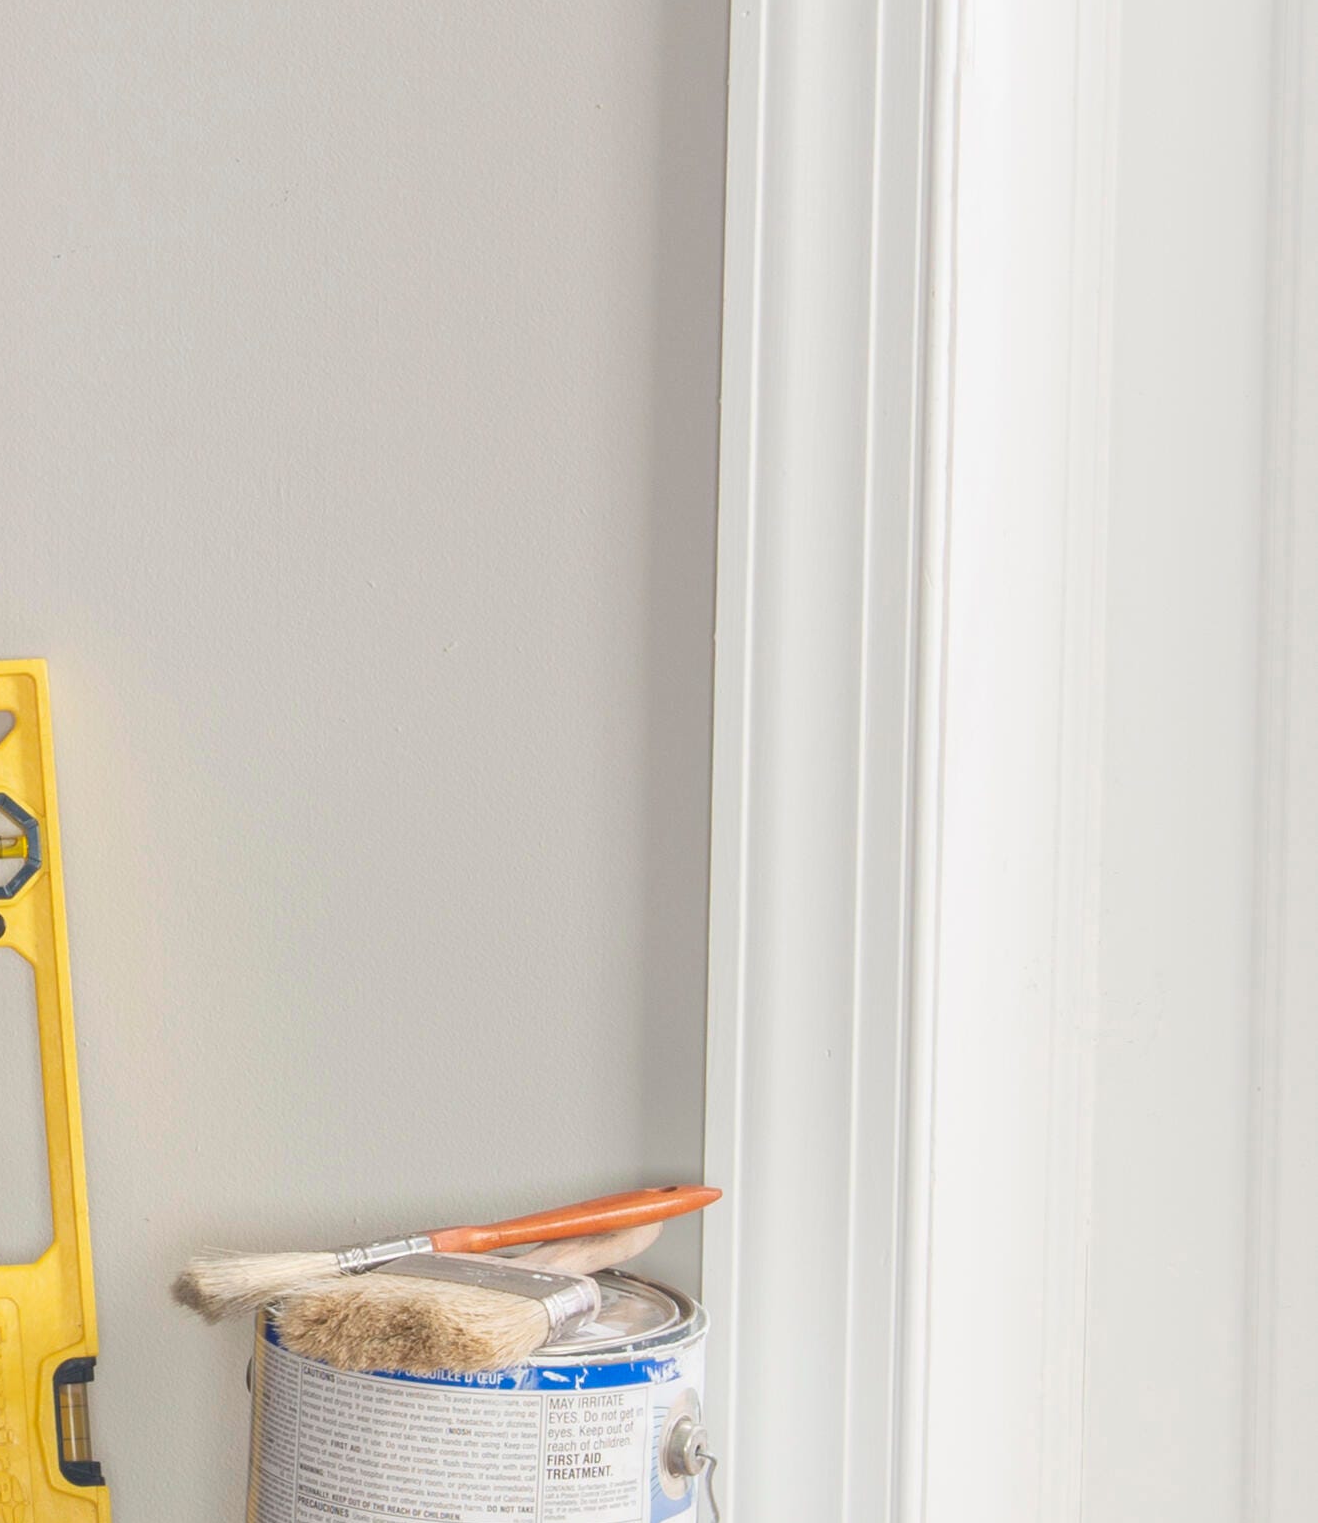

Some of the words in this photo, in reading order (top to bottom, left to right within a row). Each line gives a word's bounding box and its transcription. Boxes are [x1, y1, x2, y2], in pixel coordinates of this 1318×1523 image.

[549, 1398, 574, 1410] MAY
[578, 1394, 625, 1408] IRRITATE
[584, 1410, 598, 1423] Do
[602, 1409, 617, 1421] not
[620, 1407, 634, 1421] get
[579, 1424, 603, 1438] Keep
[607, 1423, 622, 1434] out
[625, 1421, 634, 1433] of
[547, 1441, 576, 1452] reach
[580, 1439, 591, 1451] of
[547, 1453, 580, 1466] FIRST
[583, 1452, 602, 1464] AID
[546, 1465, 613, 1480] TREATMENT.
